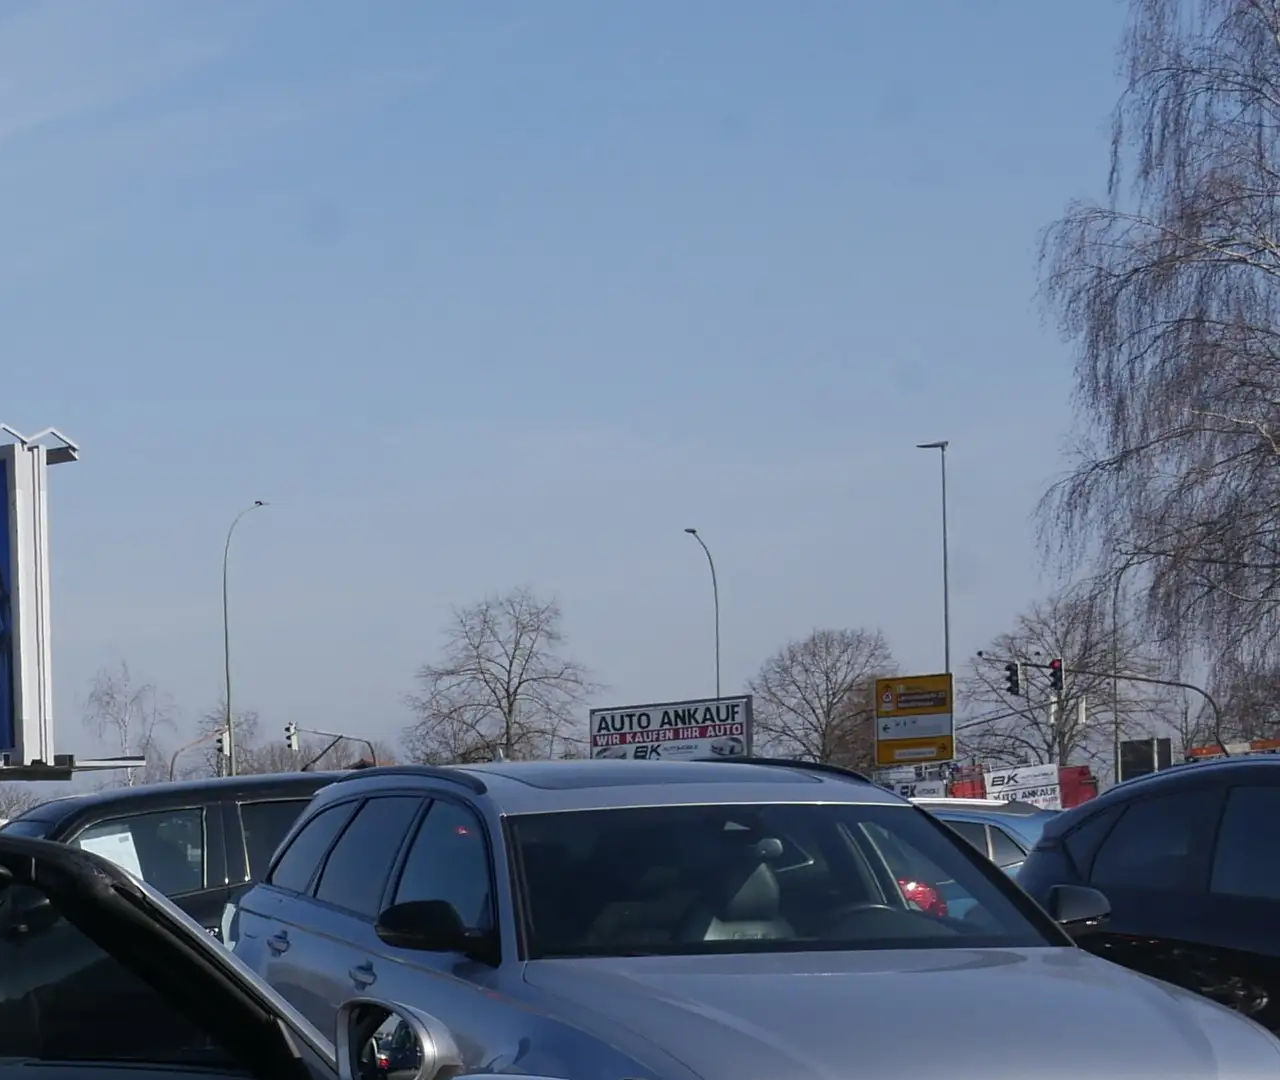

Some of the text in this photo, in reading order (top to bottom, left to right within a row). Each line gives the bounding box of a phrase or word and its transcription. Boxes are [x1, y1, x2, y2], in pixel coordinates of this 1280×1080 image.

[597, 704, 740, 733] AUTO ANKAUF
[597, 724, 741, 746] WIR KAUFEN IHR AUTO
[634, 744, 661, 760] BK
[991, 773, 1019, 787] BK
[1022, 787, 1057, 798] ANKAUF
